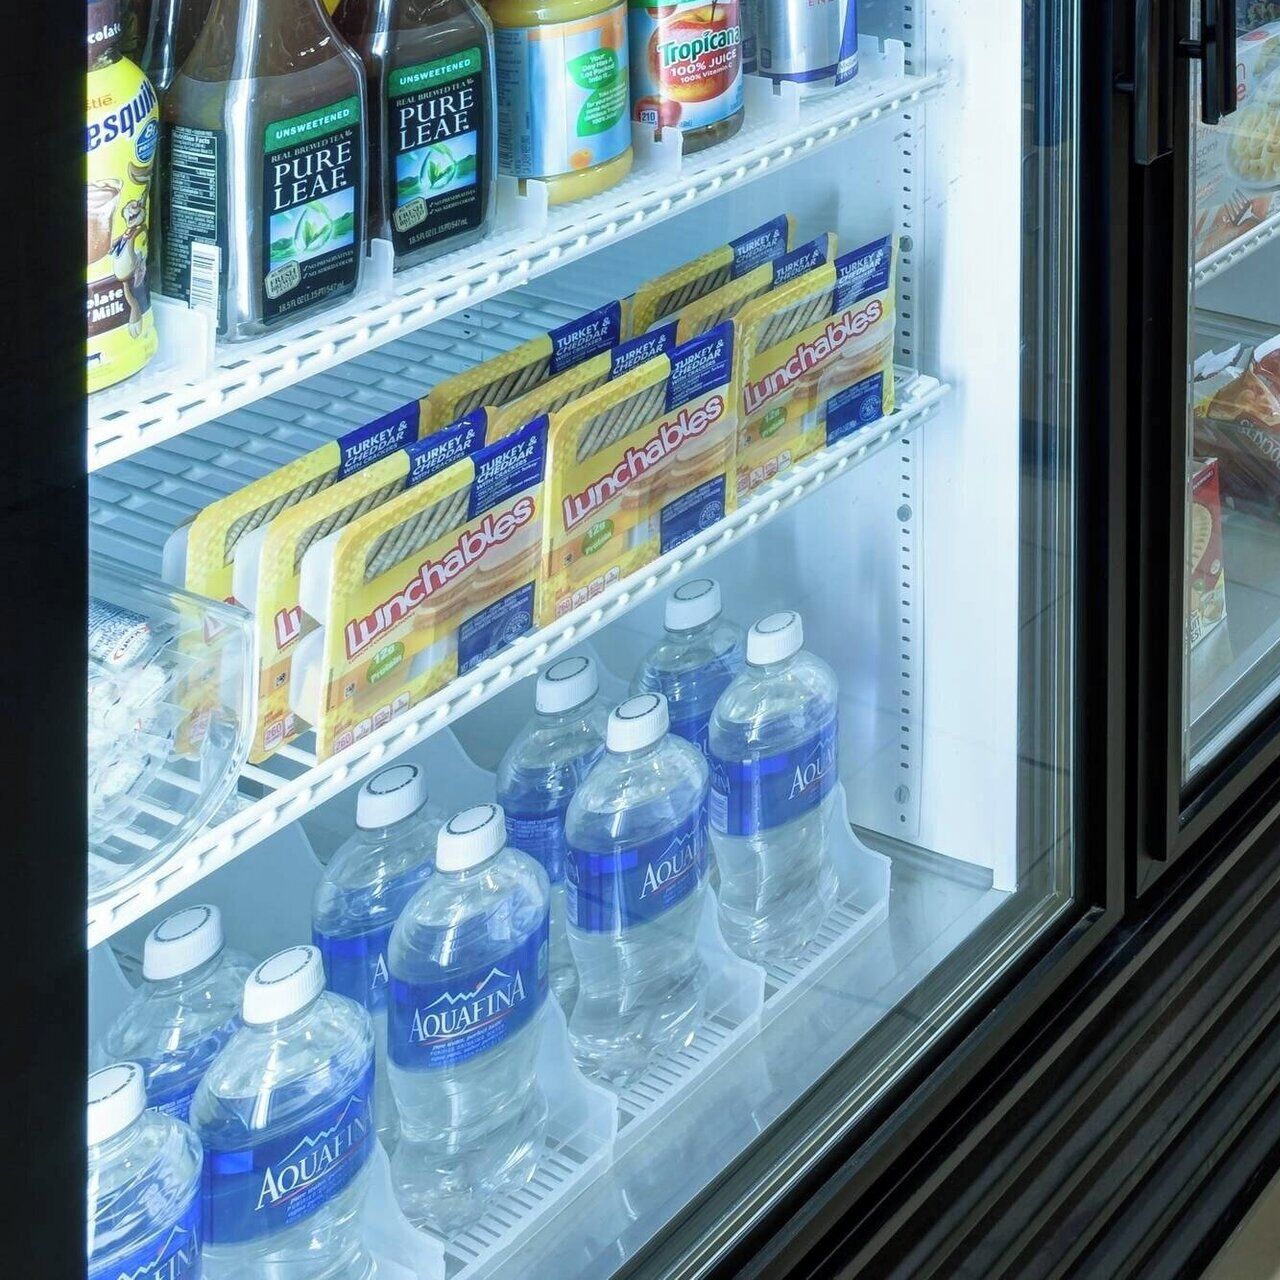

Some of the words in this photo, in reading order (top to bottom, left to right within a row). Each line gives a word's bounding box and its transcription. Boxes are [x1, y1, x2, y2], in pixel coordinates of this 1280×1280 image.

[657, 26, 741, 68] Tropicana
[671, 61, 706, 77] 100%
[709, 50, 737, 66] JUICE
[400, 58, 471, 85] UNSWEETENED
[276, 109, 349, 139] UNSWEETENED
[400, 88, 474, 129] PURE
[641, 111, 655, 121] 210
[400, 111, 469, 150] LEAF
[274, 141, 351, 187] PURE
[273, 166, 346, 211] LEAF
[93, 302, 124, 322] Milk
[744, 298, 884, 415] Lunchables
[346, 426, 394, 460] TURKEY
[562, 395, 725, 531] Lunchables
[345, 496, 536, 659] Lunchables
[408, 969, 526, 1044] AQUAFINA
